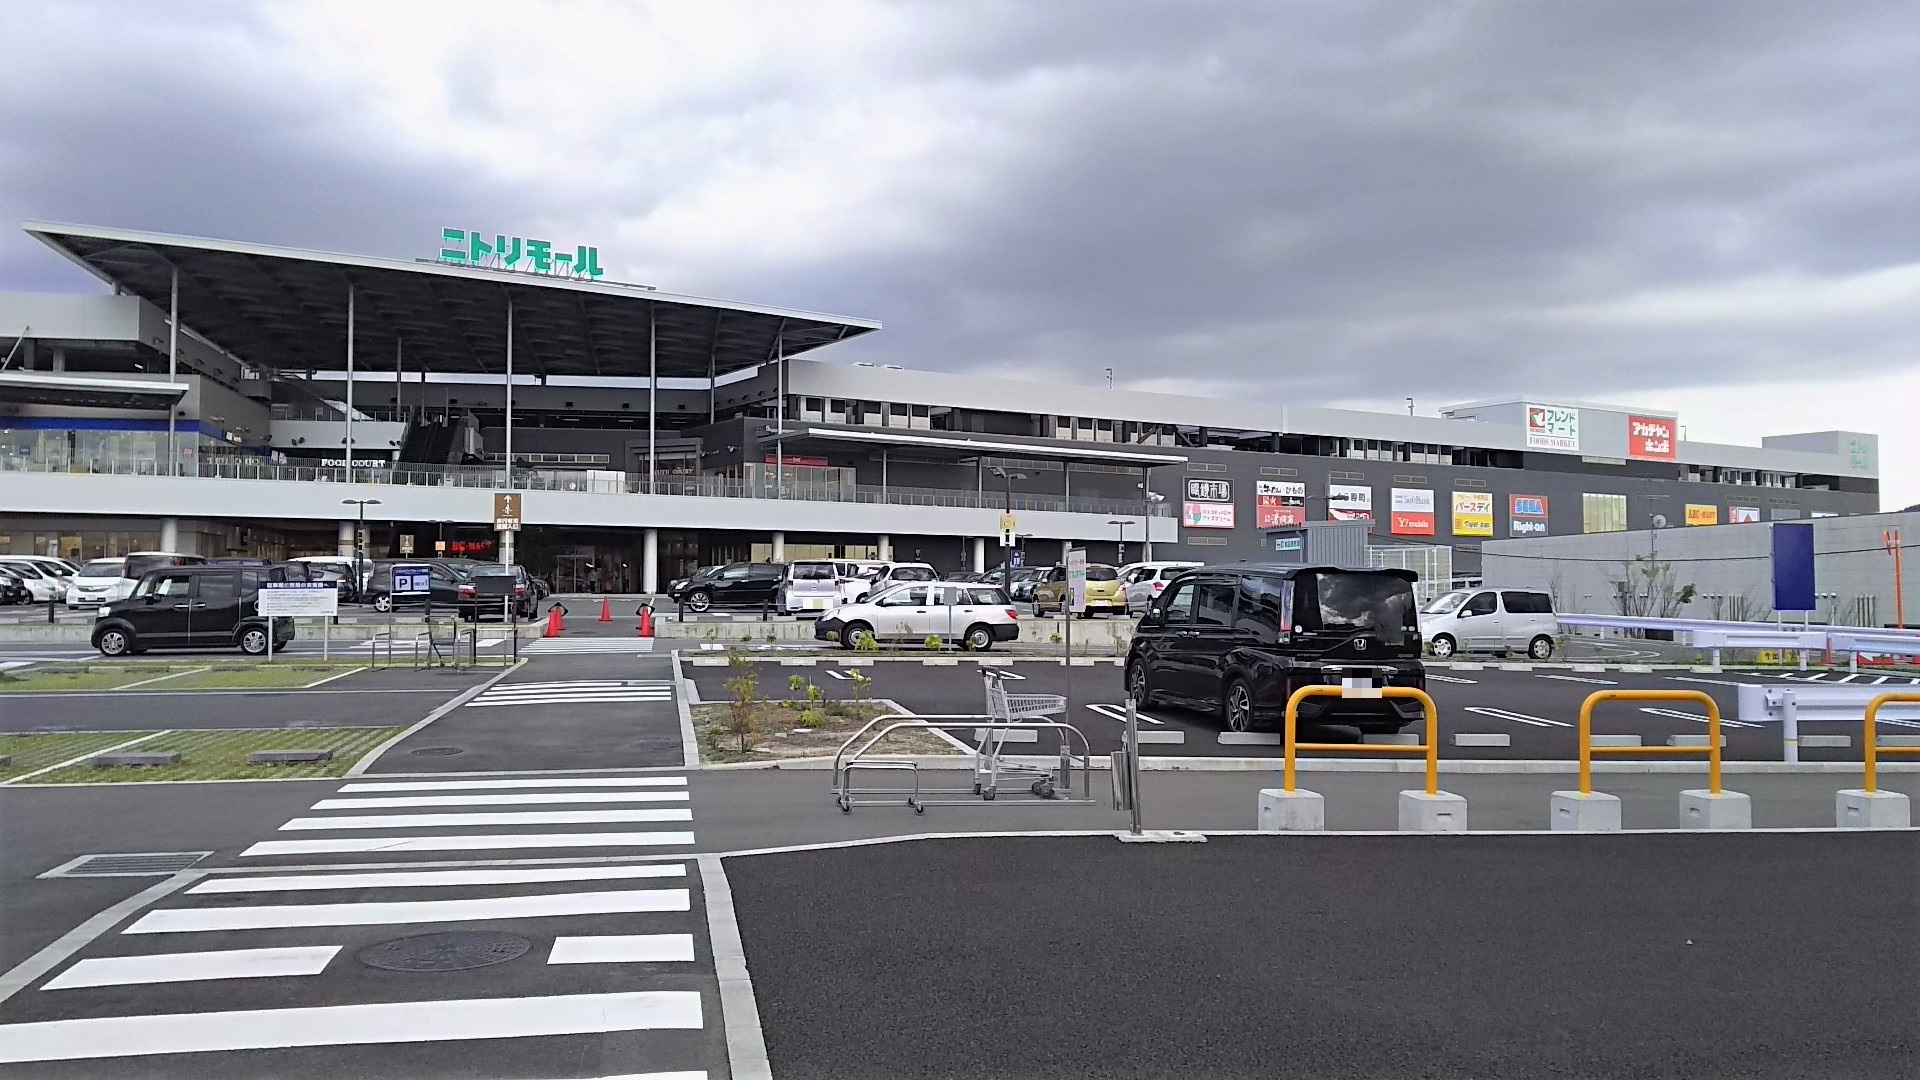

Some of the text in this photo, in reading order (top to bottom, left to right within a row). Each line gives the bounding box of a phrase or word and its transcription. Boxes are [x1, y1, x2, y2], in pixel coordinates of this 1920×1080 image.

[440, 227, 604, 276] ニトリモール
[1547, 409, 1576, 423] フレンド
[1548, 423, 1576, 436] マート
[1529, 436, 1576, 448] FOODS MARKET
[352, 460, 386, 468] COURT
[1404, 495, 1430, 505] SoftBank
[1515, 498, 1544, 514] SEGA
[1688, 508, 1716, 520] ABC-MART
[400, 578, 408, 588] P
